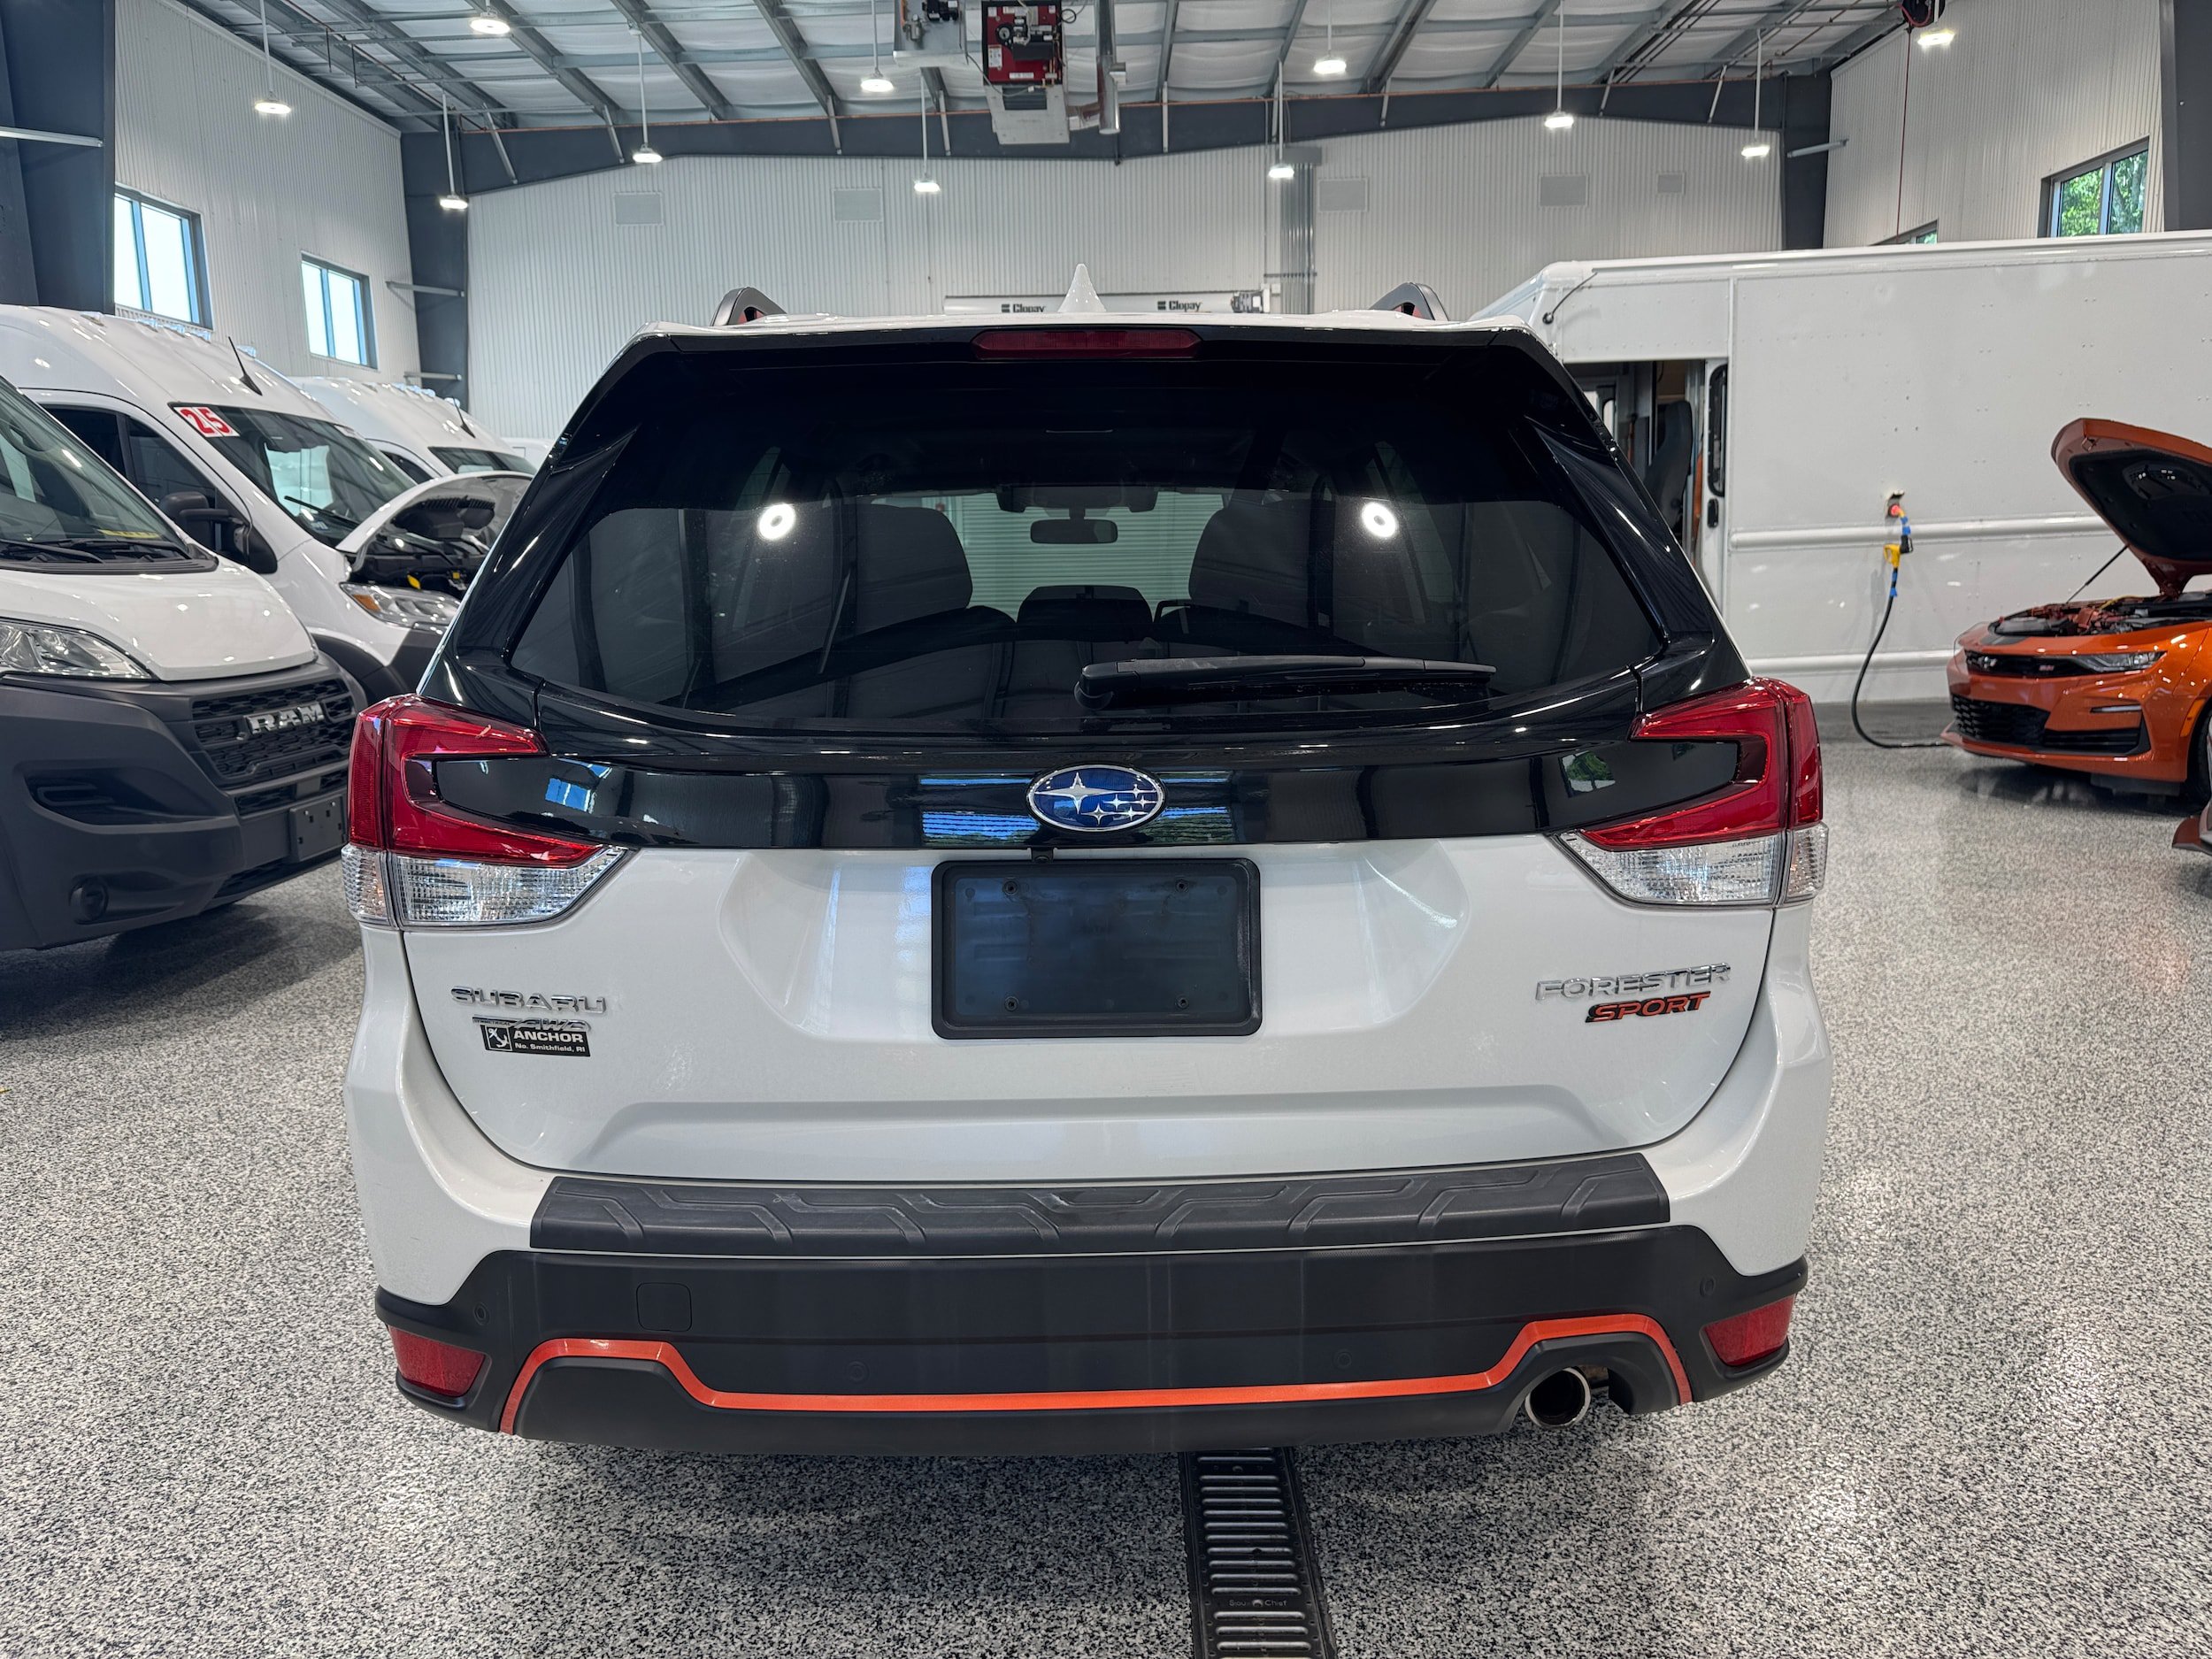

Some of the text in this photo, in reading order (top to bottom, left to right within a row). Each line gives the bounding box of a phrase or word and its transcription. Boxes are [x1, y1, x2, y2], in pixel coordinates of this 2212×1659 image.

[1169, 300, 1202, 312] Clopay
[180, 408, 230, 434] 25
[244, 702, 325, 734] RAM
[1535, 962, 1732, 1001] FORESTER
[450, 986, 607, 1014] SUBARU
[1586, 991, 1711, 1023] SPORT
[513, 1030, 584, 1043] ANCHOR
[530, 1043, 574, 1052] Smithfield,
